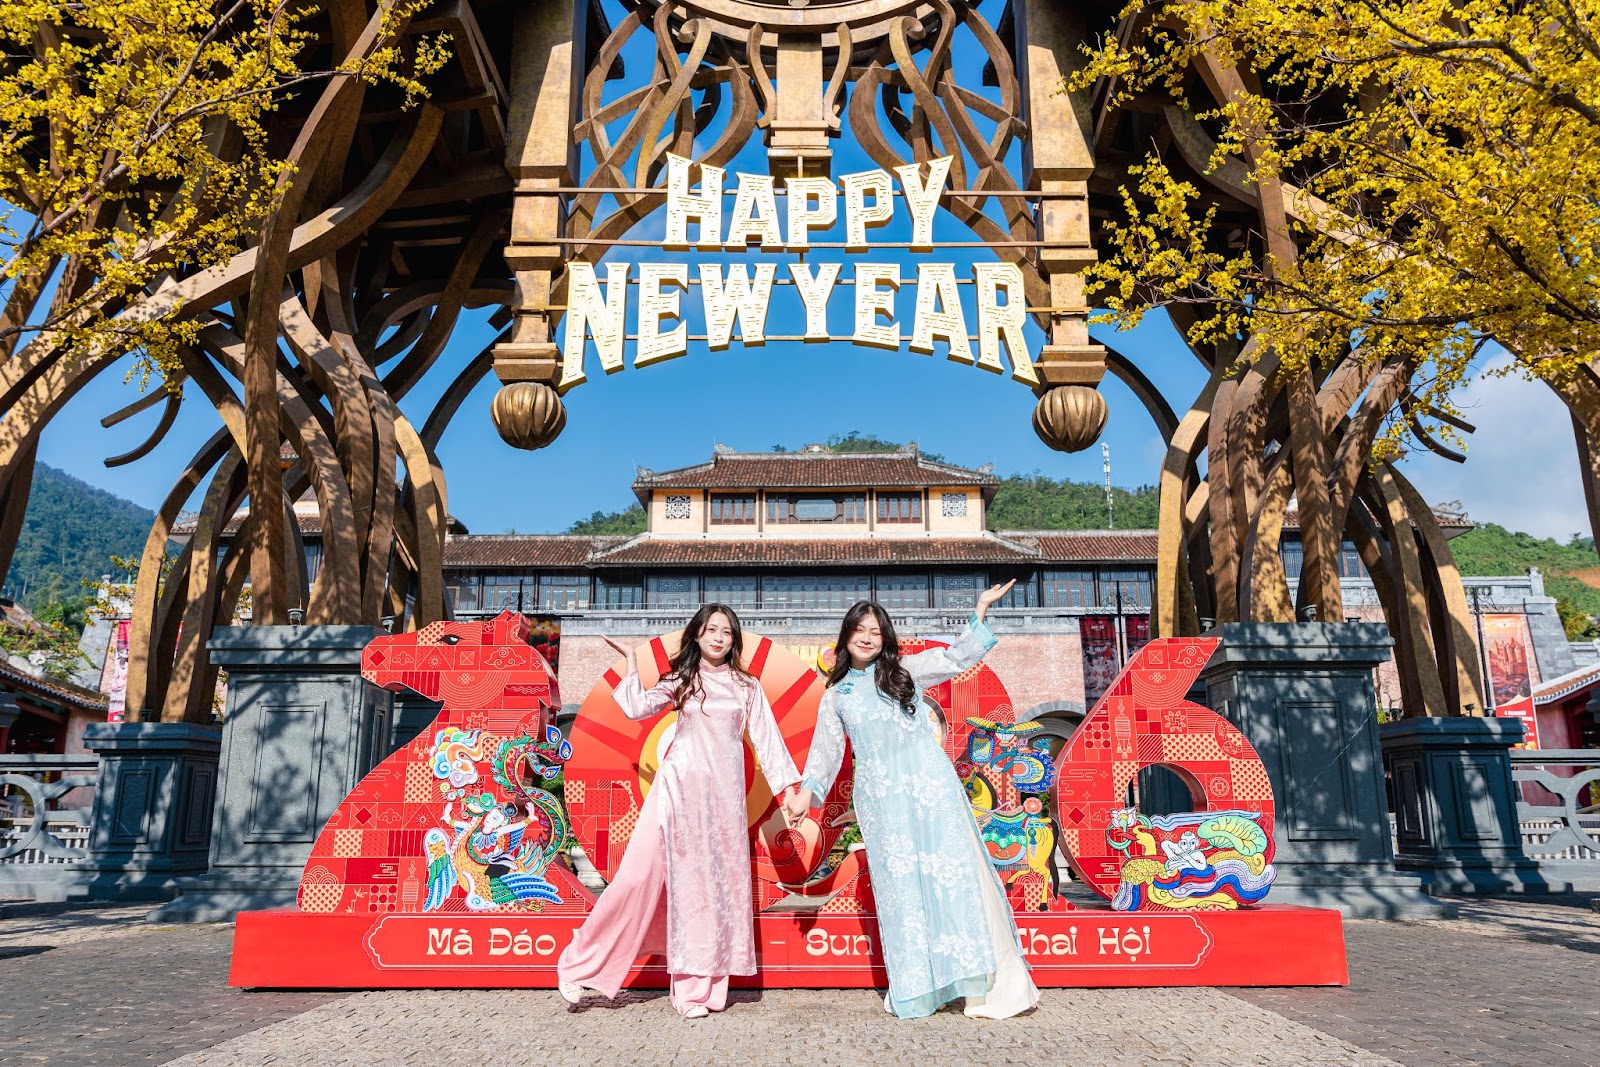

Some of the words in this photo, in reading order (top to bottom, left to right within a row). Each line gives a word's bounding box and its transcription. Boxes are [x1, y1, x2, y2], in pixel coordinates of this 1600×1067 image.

[661, 151, 954, 253] HAPPY
[558, 261, 777, 388] NEW
[788, 262, 1040, 386] YEAR
[426, 927, 474, 956] Mã
[488, 927, 557, 956] Đáo
[805, 928, 874, 956] Sun
[1096, 925, 1152, 963] Hội
